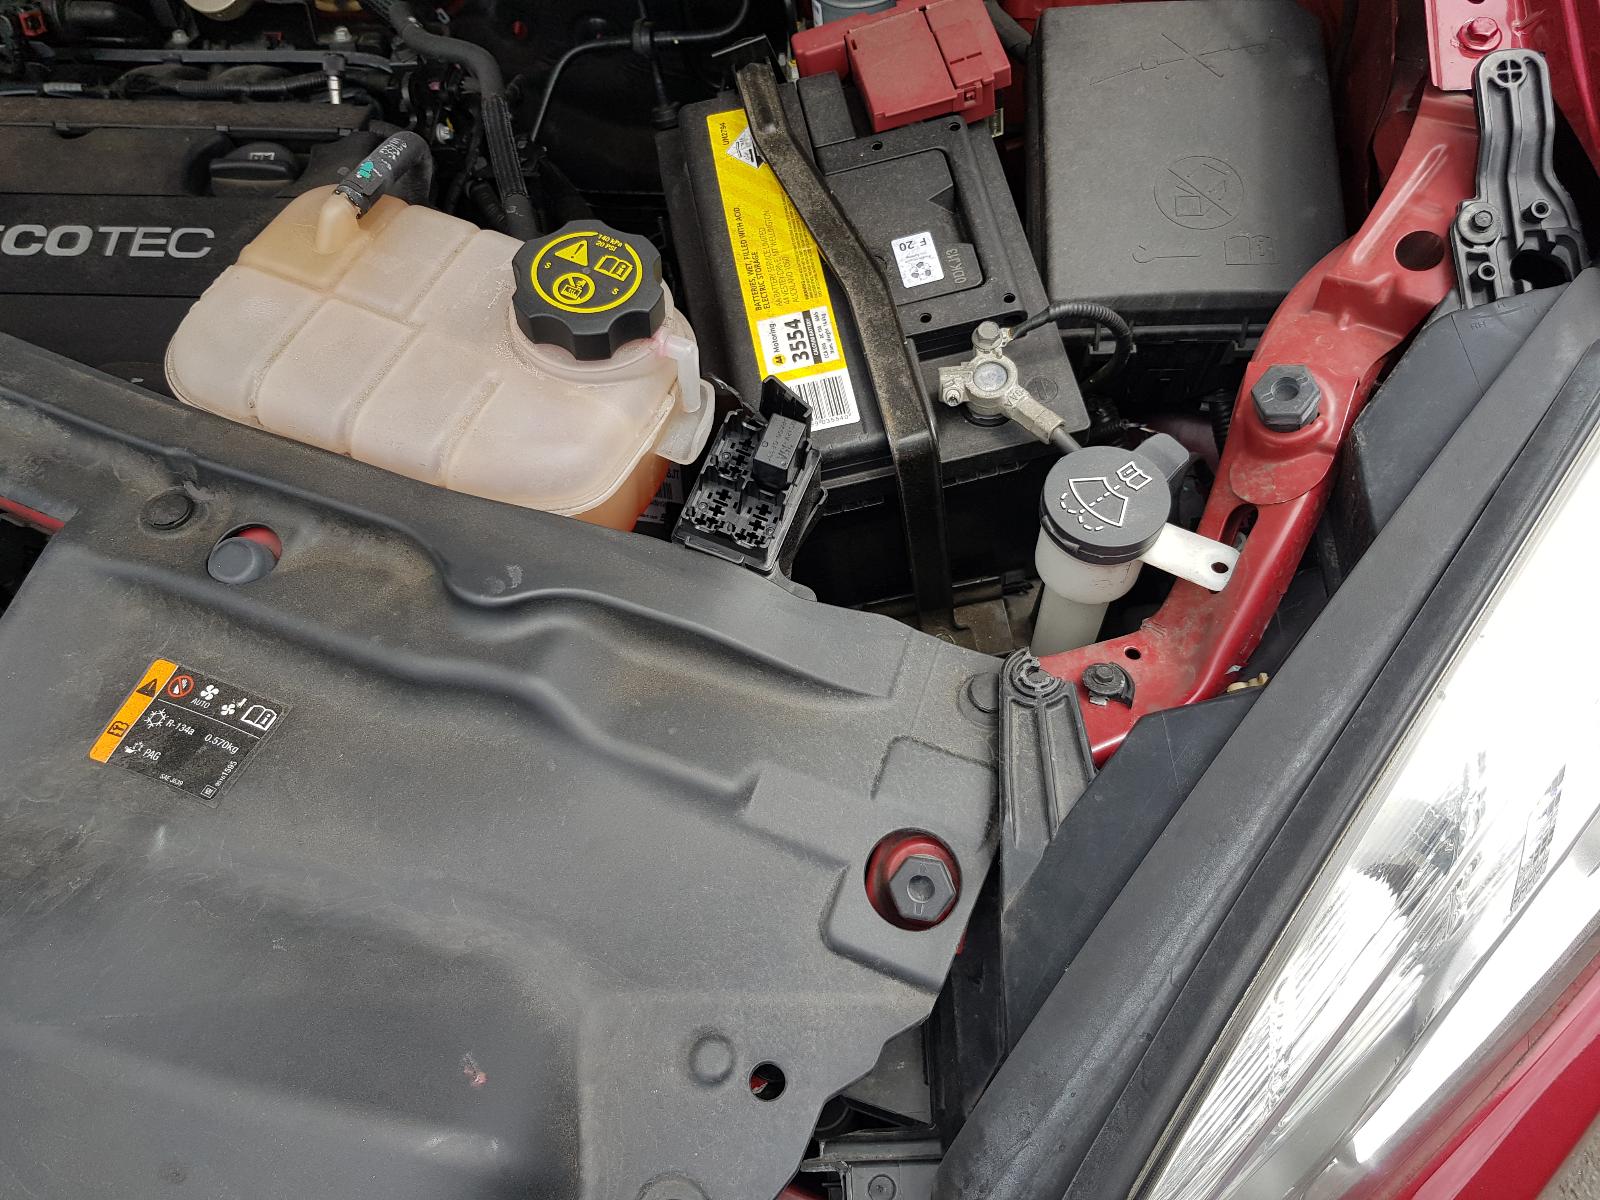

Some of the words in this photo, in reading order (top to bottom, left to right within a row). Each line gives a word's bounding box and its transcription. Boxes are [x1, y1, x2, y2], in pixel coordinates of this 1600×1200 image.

[720, 122, 729, 145] UN2794
[734, 207, 742, 221] ACID
[737, 222, 745, 238] WITH
[0, 224, 215, 259] COTEC
[598, 234, 610, 242] 140
[610, 237, 623, 247] kPa
[604, 243, 618, 252] PSI
[899, 240, 915, 252] 20
[920, 238, 927, 247] F
[741, 240, 750, 260] FILLED
[745, 260, 754, 277] WET,
[752, 251, 764, 280] STORAGE
[749, 276, 762, 311] BATTERIES,
[758, 280, 770, 310] ELECTRIC
[769, 323, 780, 353] Motoring
[784, 319, 809, 363] 3554
[191, 698, 211, 709] AUTO
[165, 719, 195, 736] R-134a
[204, 733, 239, 755] 0.570kg
[143, 748, 162, 761] PAG
[159, 773, 170, 783] SAE
